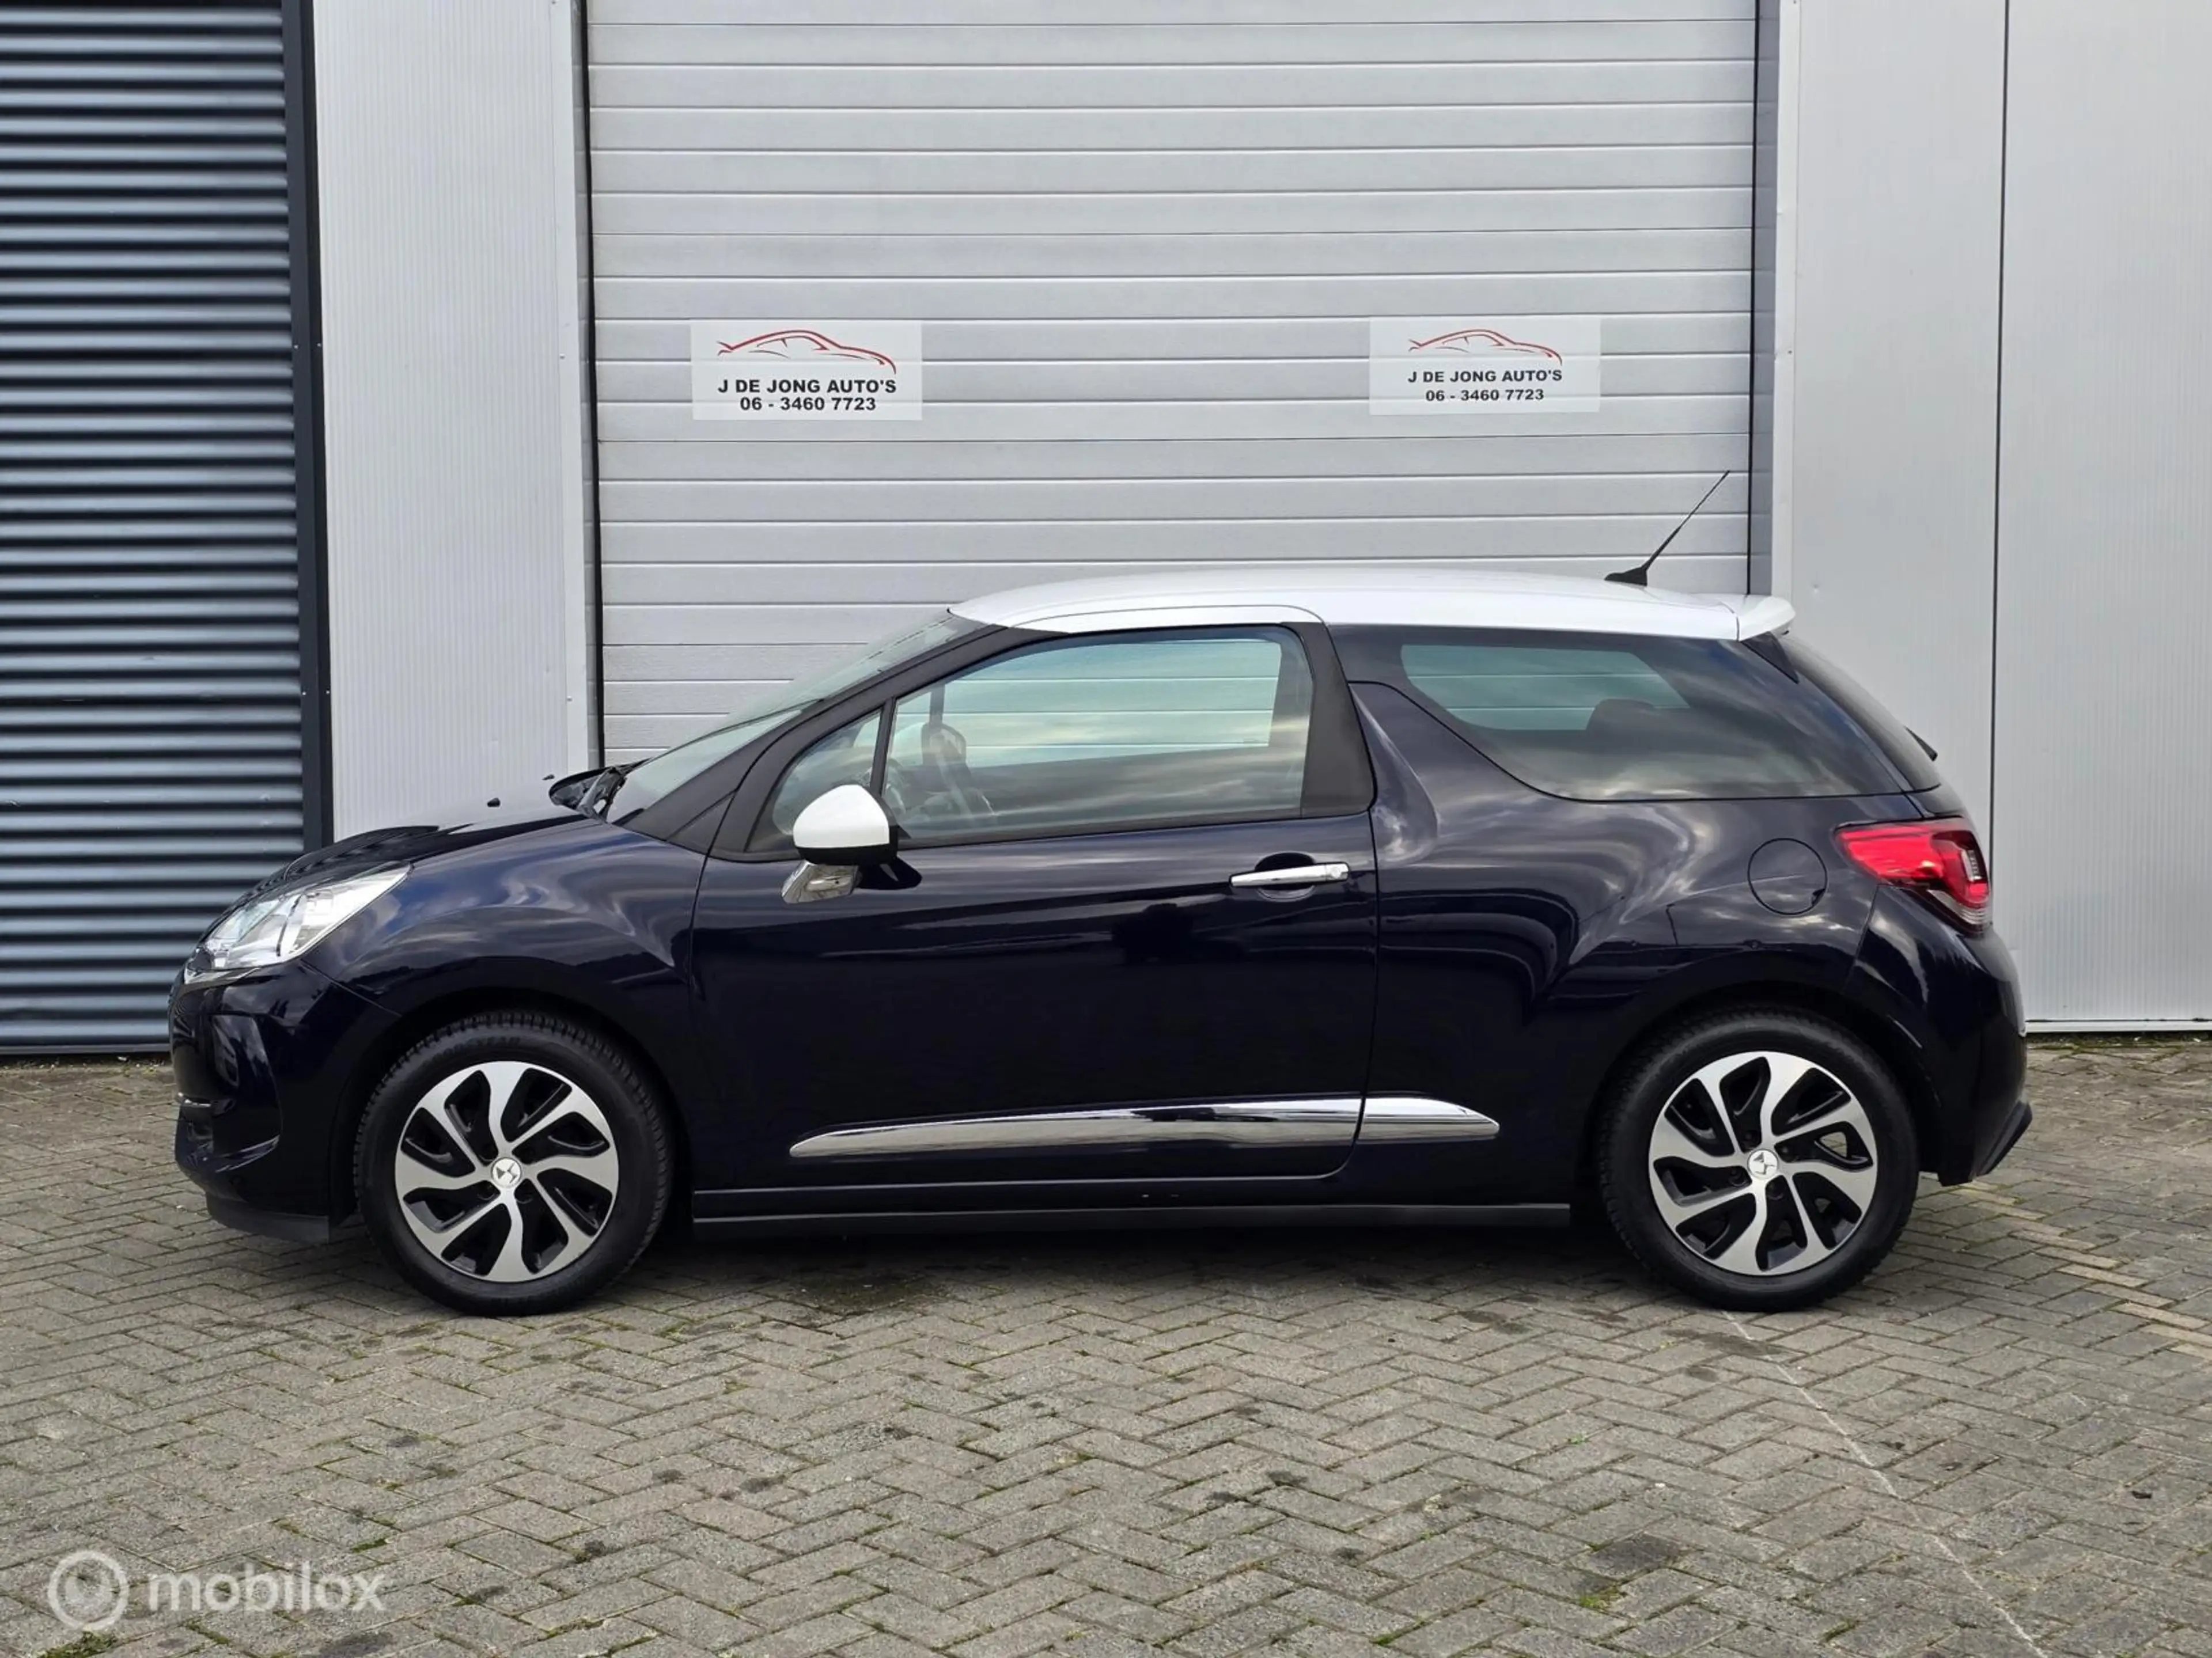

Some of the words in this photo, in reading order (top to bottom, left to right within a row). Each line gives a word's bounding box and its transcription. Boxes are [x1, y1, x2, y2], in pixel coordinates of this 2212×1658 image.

[1408, 371, 1417, 383] J
[1423, 371, 1444, 382] DE
[1449, 370, 1497, 382] JONG
[1502, 369, 1562, 382] AUTO'S
[718, 380, 728, 393] J
[736, 380, 760, 393] DE
[767, 380, 820, 393] JONG
[827, 380, 896, 393] AUTO'S
[1426, 390, 1445, 401] 06
[1461, 389, 1499, 401] 3460
[1505, 389, 1544, 400] 7723
[740, 397, 762, 411] 06
[781, 397, 825, 411] 3460
[831, 397, 876, 411] 7723
